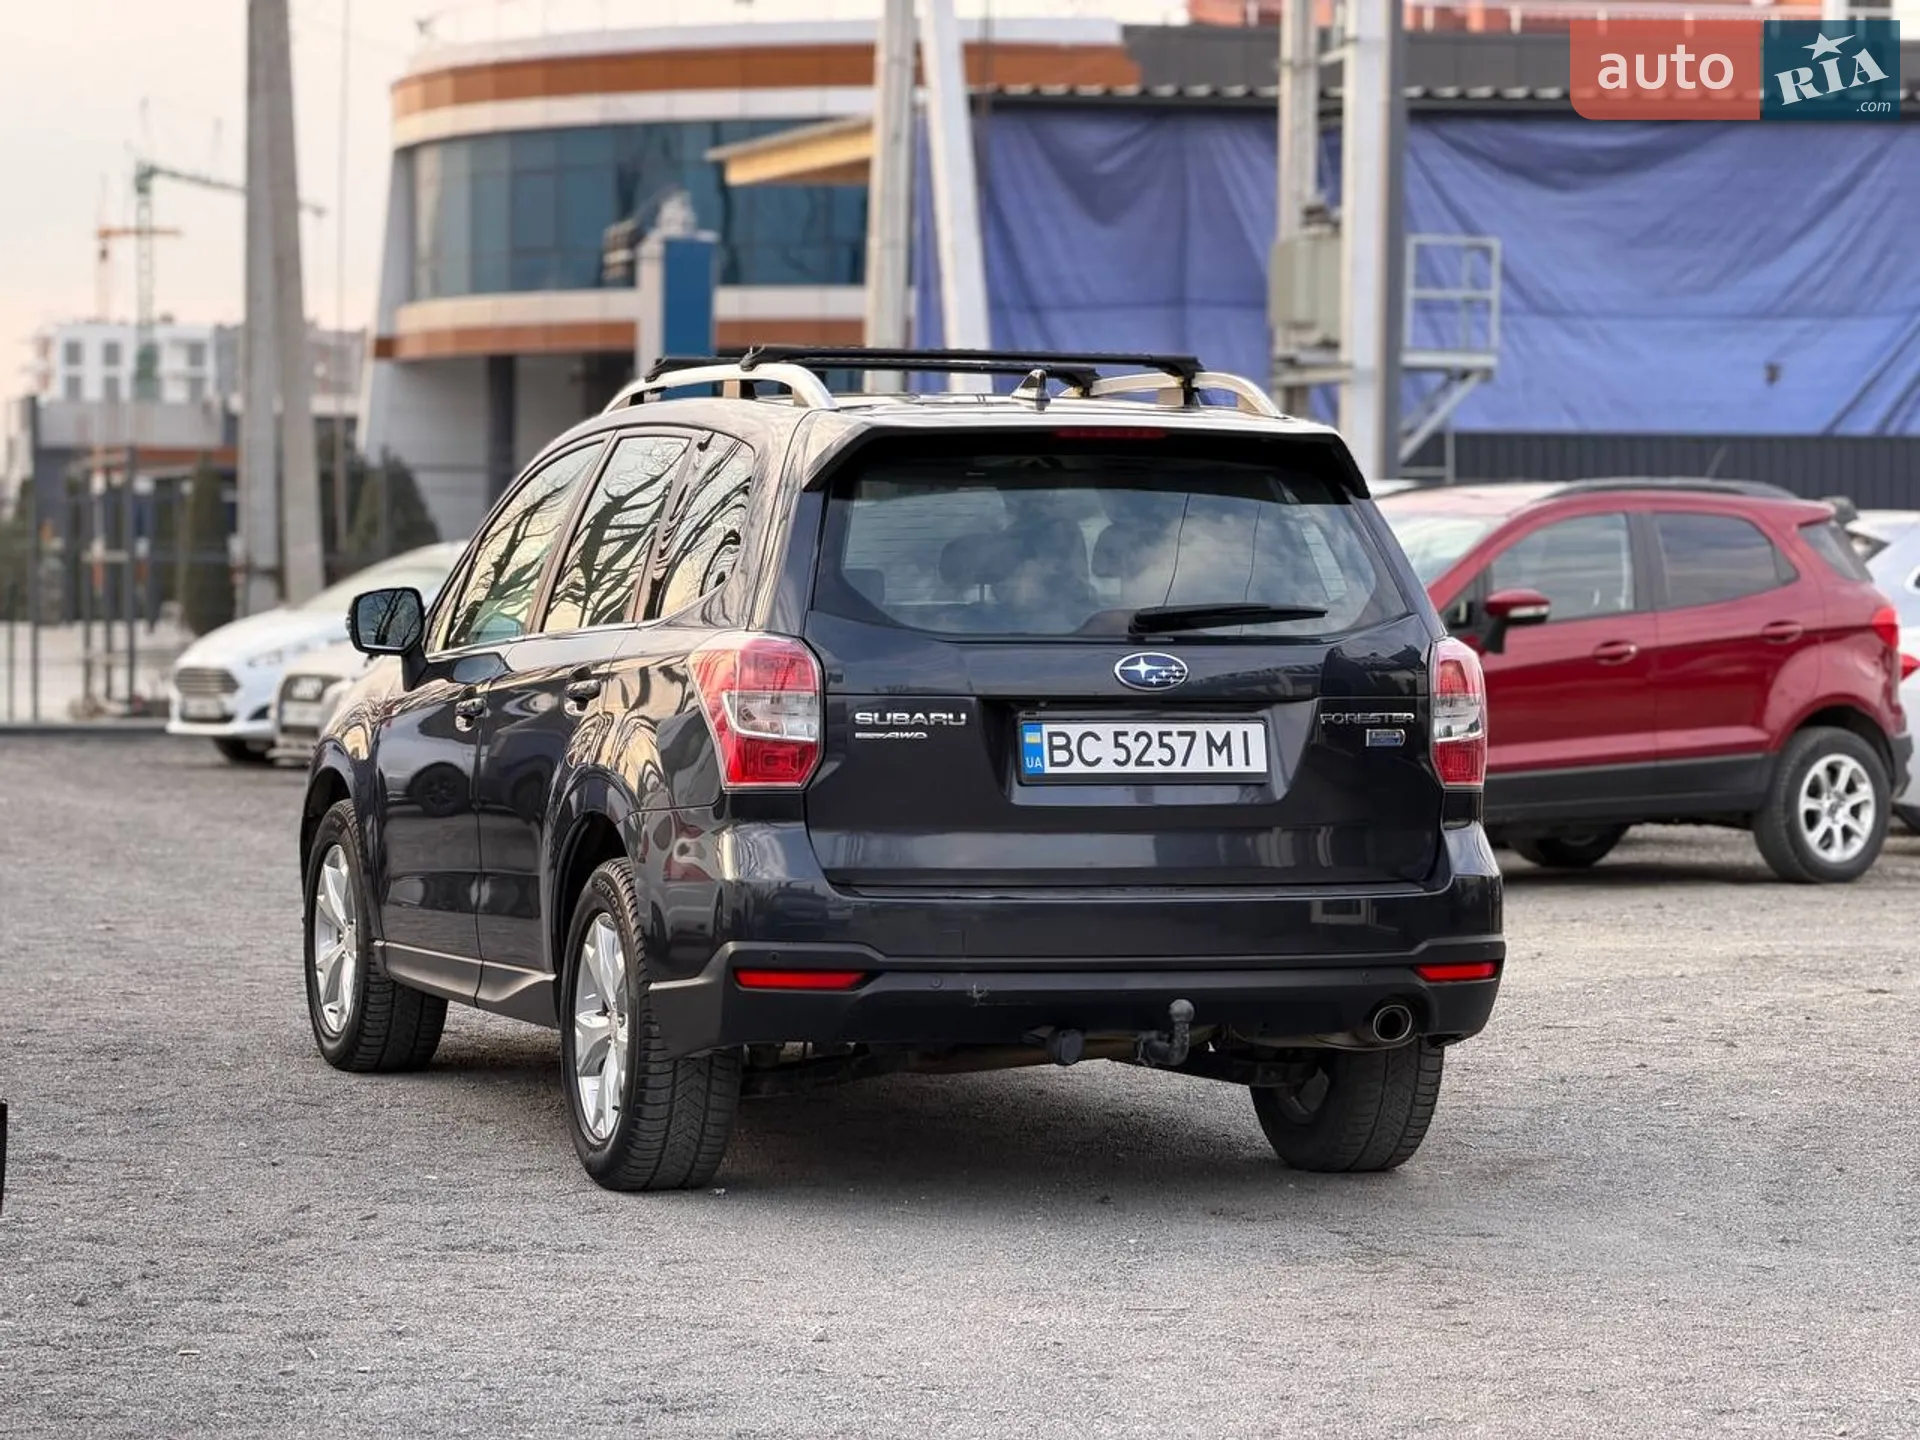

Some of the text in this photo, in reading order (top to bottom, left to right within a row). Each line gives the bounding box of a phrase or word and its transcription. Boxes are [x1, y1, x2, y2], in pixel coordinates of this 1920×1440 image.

[855, 712, 966, 726] SUBARU
[1320, 712, 1415, 724] FORESTER
[1047, 731, 1250, 767] BC 5257 MI
[1025, 757, 1043, 769] UA
